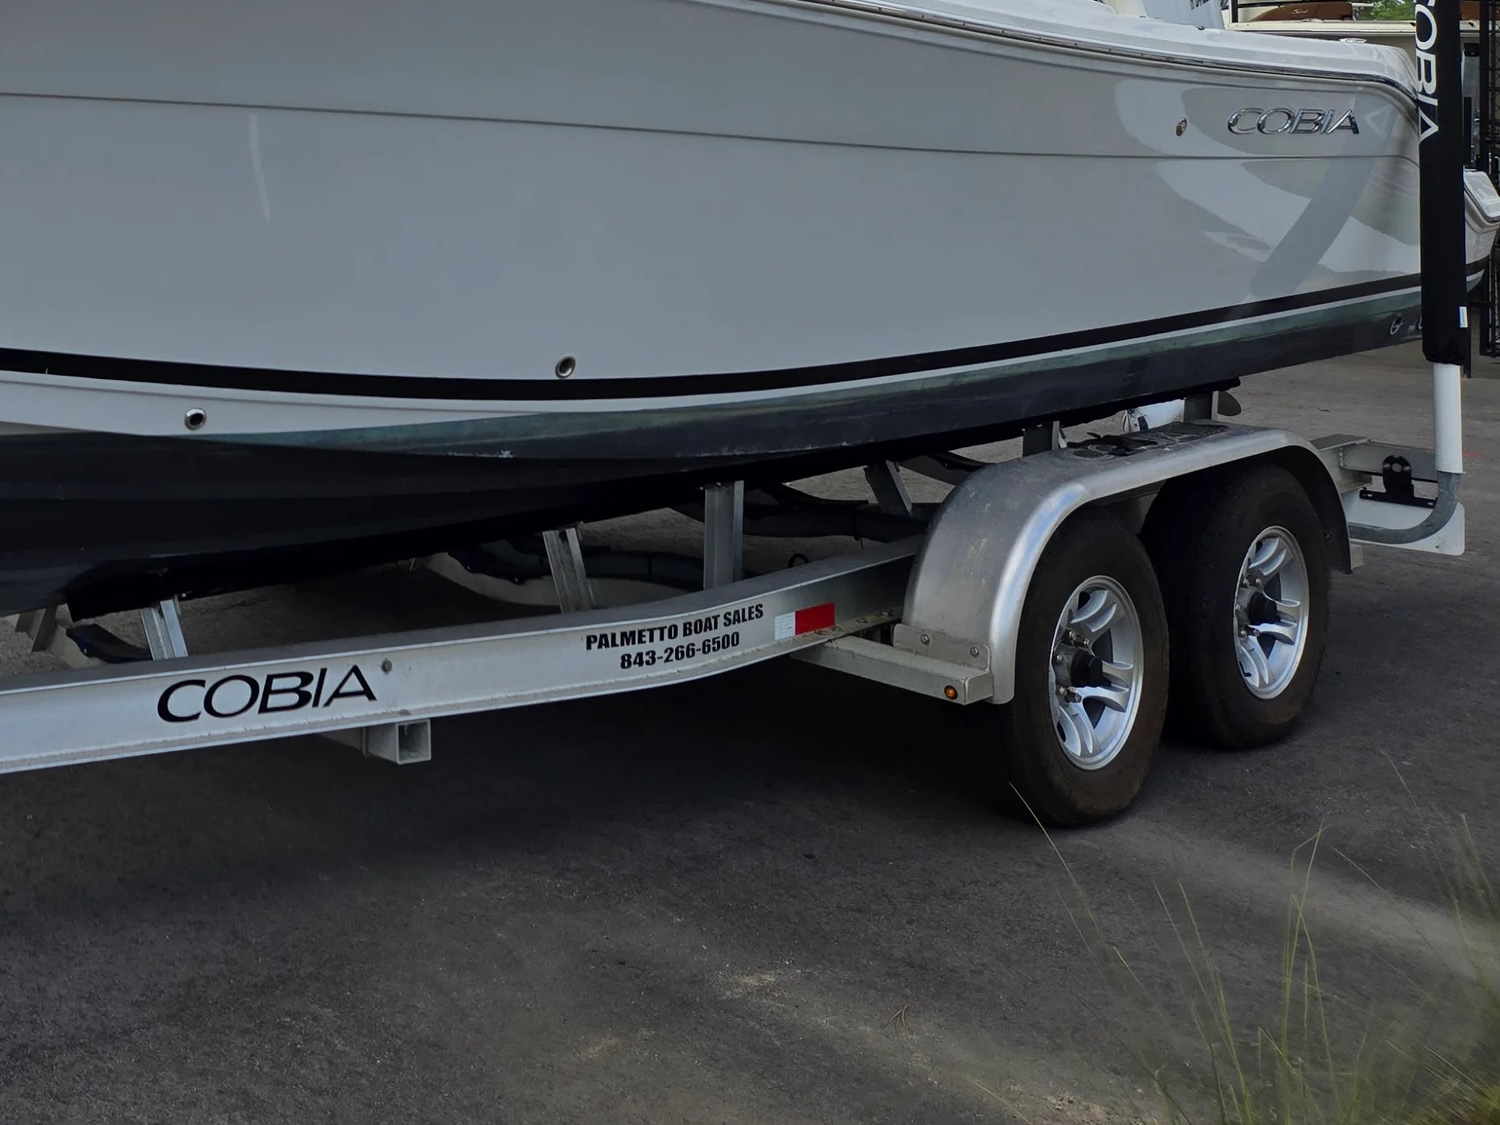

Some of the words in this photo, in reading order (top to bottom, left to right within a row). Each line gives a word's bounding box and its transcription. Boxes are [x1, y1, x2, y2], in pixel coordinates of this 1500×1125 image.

[1227, 107, 1360, 135] COBIA
[586, 624, 678, 651] PALMETTO
[682, 614, 720, 637] BOAT
[723, 604, 764, 627] SALES
[620, 631, 740, 670] 843-266-6500
[157, 664, 378, 723] COBIA
